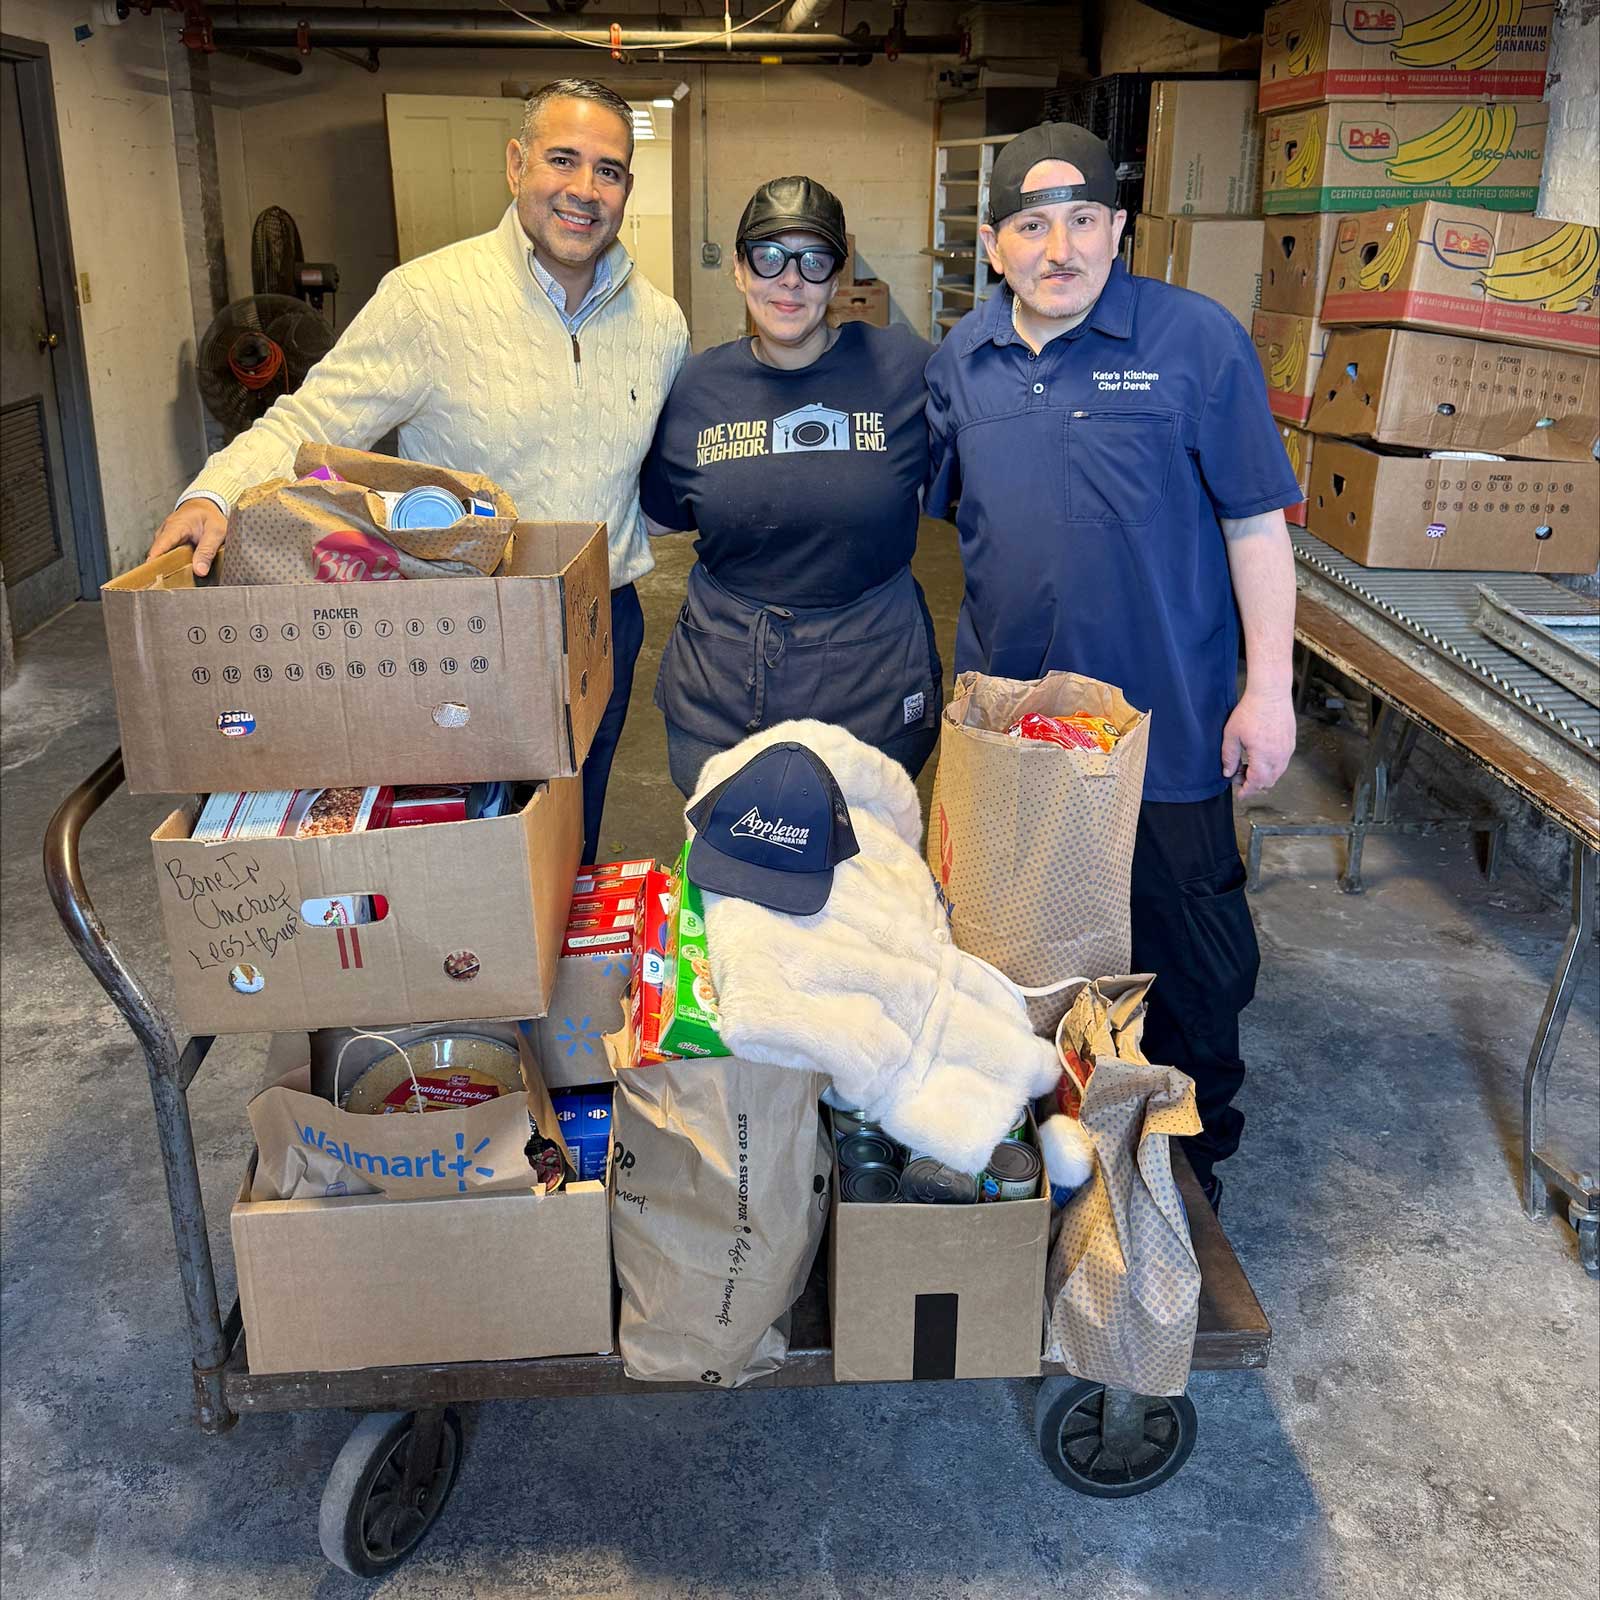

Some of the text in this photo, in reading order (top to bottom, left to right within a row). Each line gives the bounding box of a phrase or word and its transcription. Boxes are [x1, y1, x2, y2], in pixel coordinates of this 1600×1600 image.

[1354, 9, 1396, 27] Dole
[1497, 25, 1547, 38] PREMIUM
[1495, 40, 1546, 51] BANANAS
[1335, 75, 1366, 83] PREMIUM
[1407, 74, 1439, 82] PREMIUM
[1349, 128, 1391, 145] Dole
[1472, 149, 1541, 161] ORGANIC
[1331, 188, 1534, 199] CERTIFIED ORGANIC BANANAS CERTIFIED ORGANIC
[1443, 228, 1490, 253] Dole
[1092, 370, 1159, 381] Kate's Kitchen
[1097, 381, 1151, 391] Chef Derek
[852, 412, 885, 432] THE
[697, 420, 767, 448] LOVE YOUR
[855, 432, 887, 451] END.
[696, 437, 769, 467] NEIGHBOR.
[313, 607, 359, 620] PACKER
[469, 619, 483, 631] 10
[193, 658, 487, 681] 11 12 13 14 15 16 17 18 19 20
[742, 811, 811, 839] Appleton
[768, 833, 808, 846] CORPORATION
[687, 915, 697, 929] 8
[649, 960, 660, 973] 9
[410, 1083, 493, 1101] Graham Cracker
[737, 1113, 748, 1150] STOP
[738, 1164, 749, 1201] SHOP
